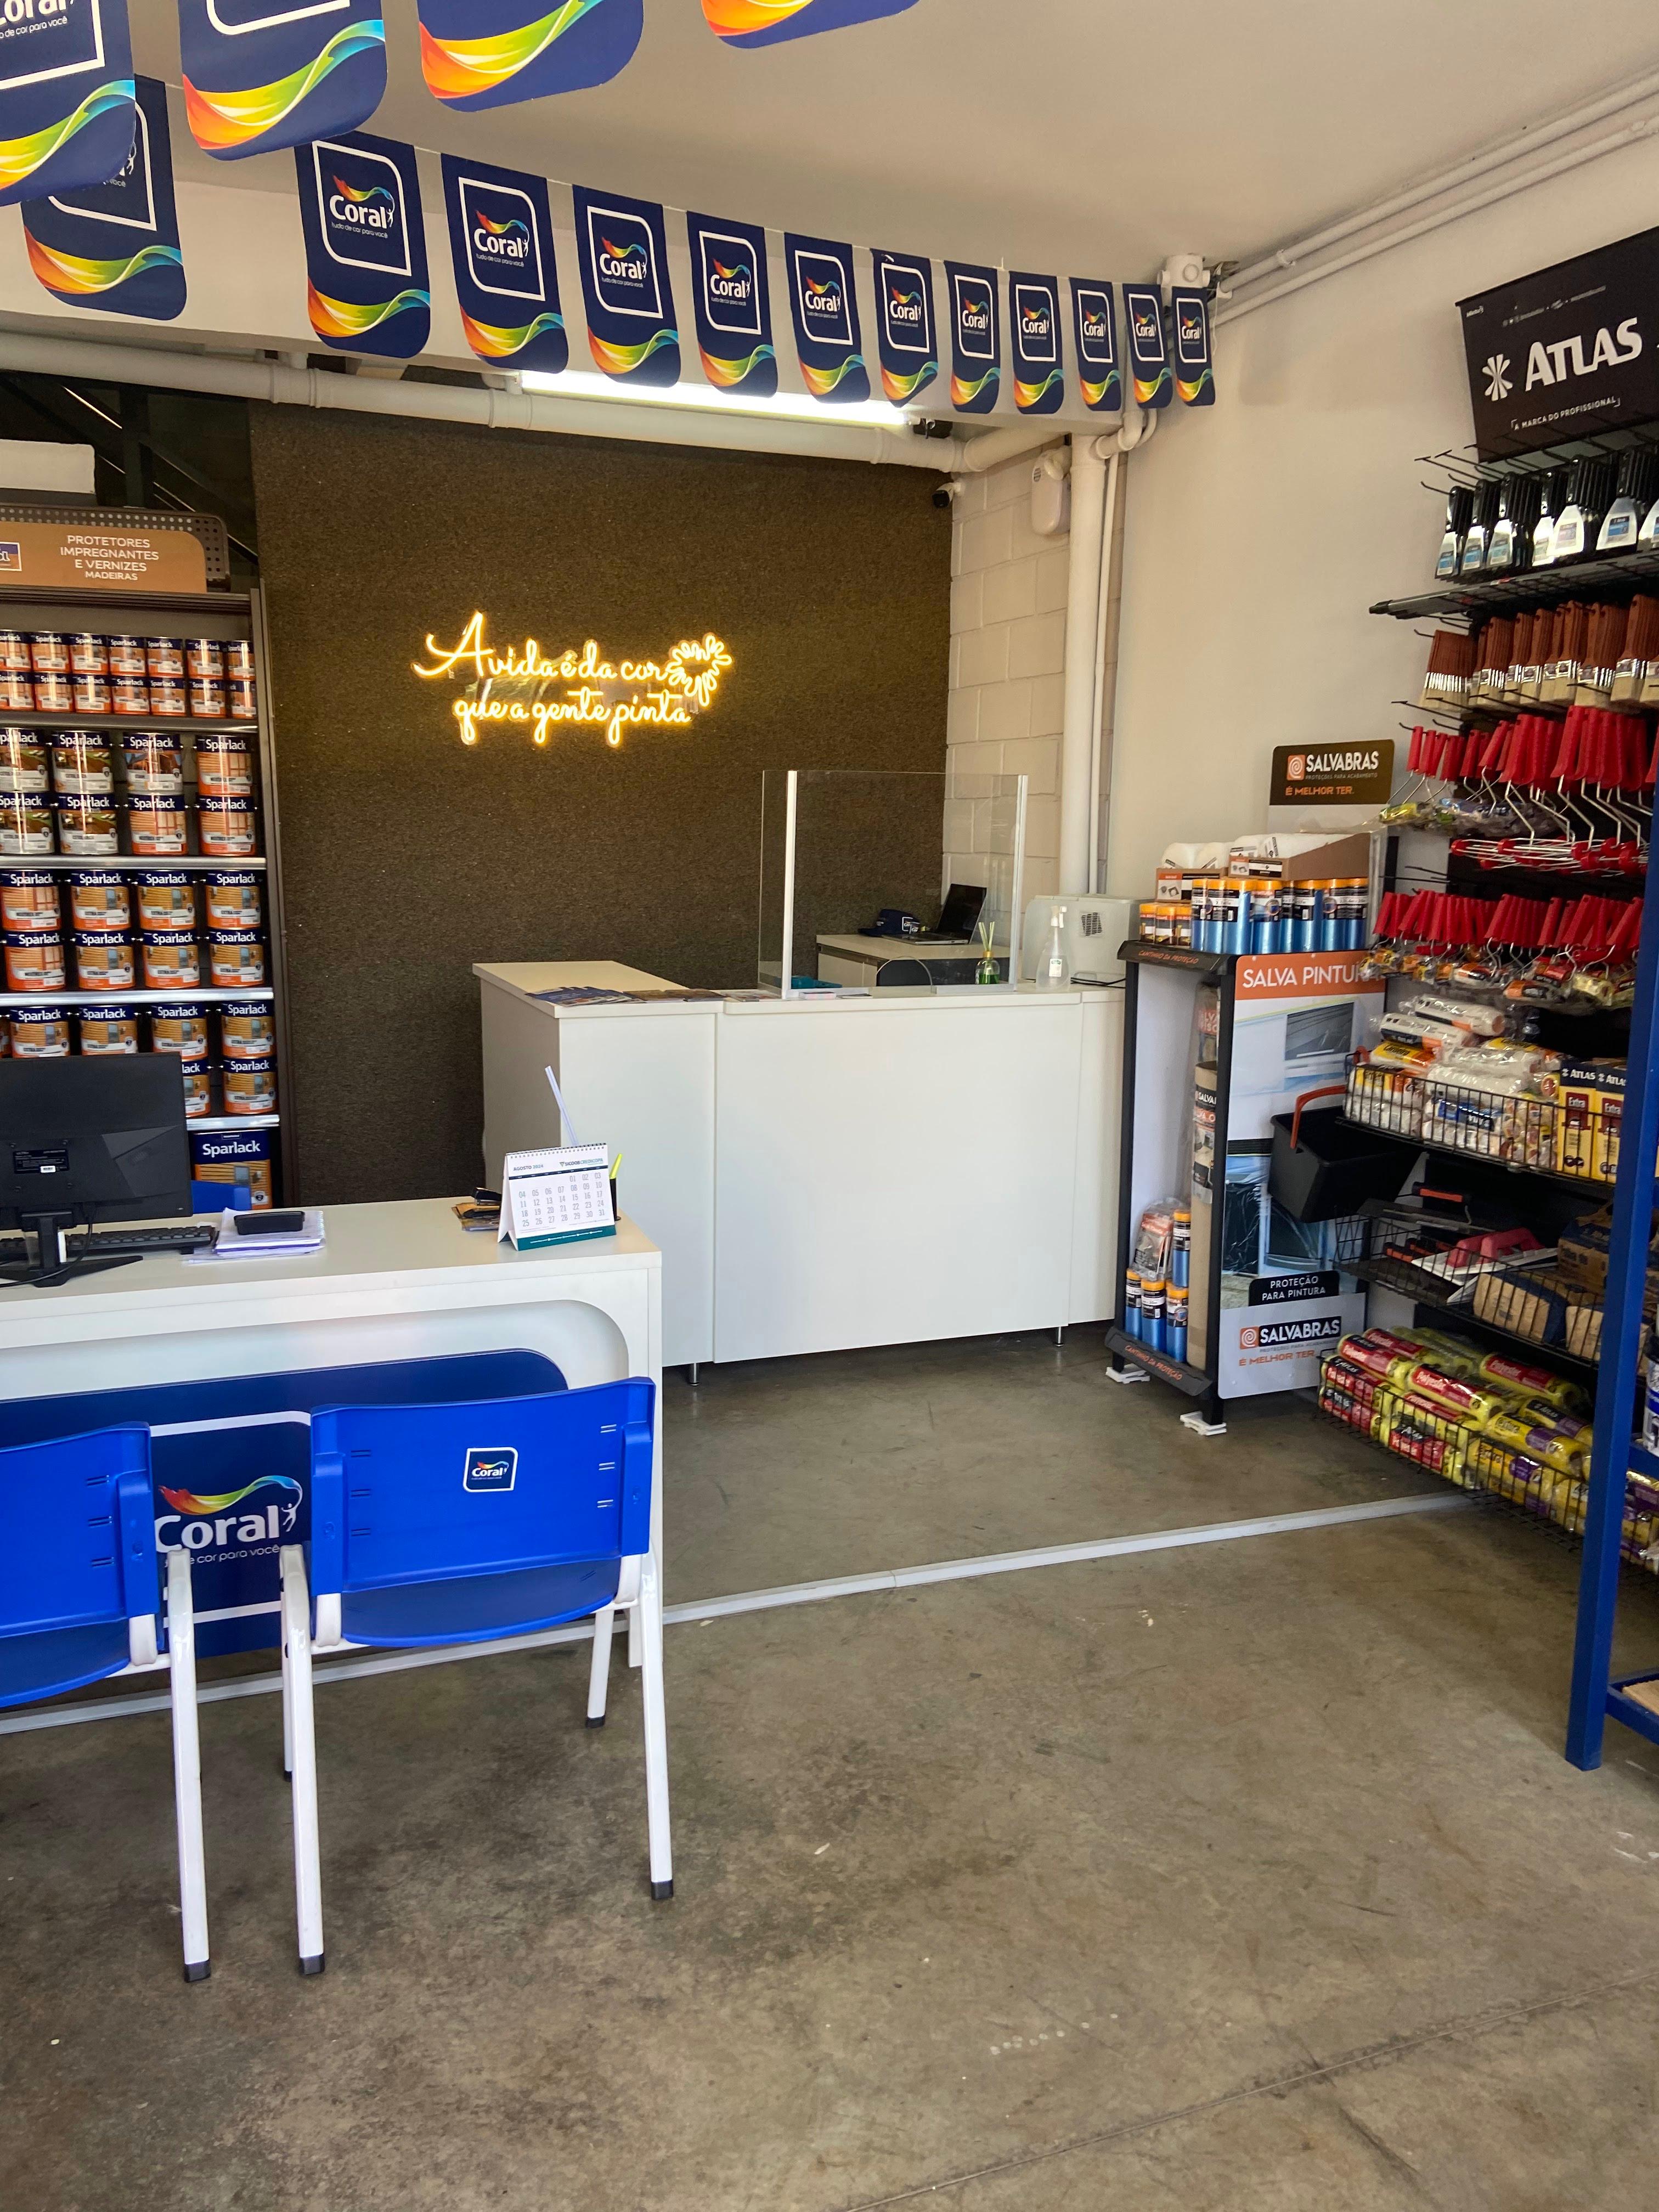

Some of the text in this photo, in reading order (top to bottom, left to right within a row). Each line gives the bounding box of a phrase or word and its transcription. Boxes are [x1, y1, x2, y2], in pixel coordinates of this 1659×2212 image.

[4, 29, 15, 37] de
[29, 21, 47, 33] para
[48, 16, 68, 26] você
[330, 195, 387, 229] Coral
[474, 228, 523, 258] Coral
[600, 253, 642, 280] Coral
[710, 274, 746, 298] Coral
[805, 290, 837, 312] Coral
[890, 300, 918, 321] Coral
[962, 310, 985, 329] Coral
[1022, 317, 1046, 334] Coral
[1084, 320, 1104, 337] Coral
[1136, 323, 1155, 337] Coral
[1181, 326, 1201, 340] Coral
[1525, 317, 1643, 392] ATLAS
[1522, 416, 1547, 428] MARCA
[1548, 412, 1560, 421] DO
[1560, 396, 1616, 418] PROFISSIONAL
[67, 535, 150, 548] PROTETORES
[60, 546, 160, 560] IMPREGNANTES
[75, 559, 147, 572] E VERNIZES
[85, 571, 138, 580] MADEIRAS
[411, 610, 668, 680] A vida é da cor
[453, 686, 691, 746] que a gente pinta
[59, 734, 103, 747] Sparlack
[130, 737, 173, 749] Sparlack
[206, 739, 246, 752] Sparlack
[1306, 751, 1379, 772] SALVABRAS
[1285, 786, 1293, 795] É
[1294, 787, 1334, 795] MELHOR
[67, 797, 110, 809] Sparlack
[134, 798, 175, 810] Sparlack
[206, 798, 247, 810] Sparlack
[10, 873, 53, 886] Sparlack
[80, 873, 122, 886] Sparlack
[146, 873, 187, 886] Sparlack
[217, 873, 255, 885] Sparlack
[19, 933, 60, 946] Sparlack
[82, 933, 124, 946] Sparlack
[153, 933, 193, 945] Sparlack
[216, 932, 256, 944] Sparlack
[1243, 967, 1297, 988] SALVA
[18, 1009, 61, 1023] Sparlack
[83, 1008, 126, 1020] Sparlack
[157, 1006, 198, 1018] Sparlack
[228, 1004, 267, 1015] Sparlack
[182, 1063, 200, 1074] lack
[230, 1060, 269, 1072] Sparlack
[1570, 1069, 1595, 1080] ATLAS
[202, 1140, 261, 1158] Sparlack
[1270, 1276, 1319, 1289] PROTEÇÃO
[1262, 1286, 1326, 1301] PARA PINTURA
[1260, 1319, 1340, 1344] SALVABRAS
[1239, 1350, 1316, 1367] É MELHOR TER
[472, 1468, 503, 1477] Coral
[155, 1505, 279, 1553] Coral
[197, 1553, 218, 1564] cor
[219, 1550, 247, 1562] para
[250, 1544, 281, 1556] você
